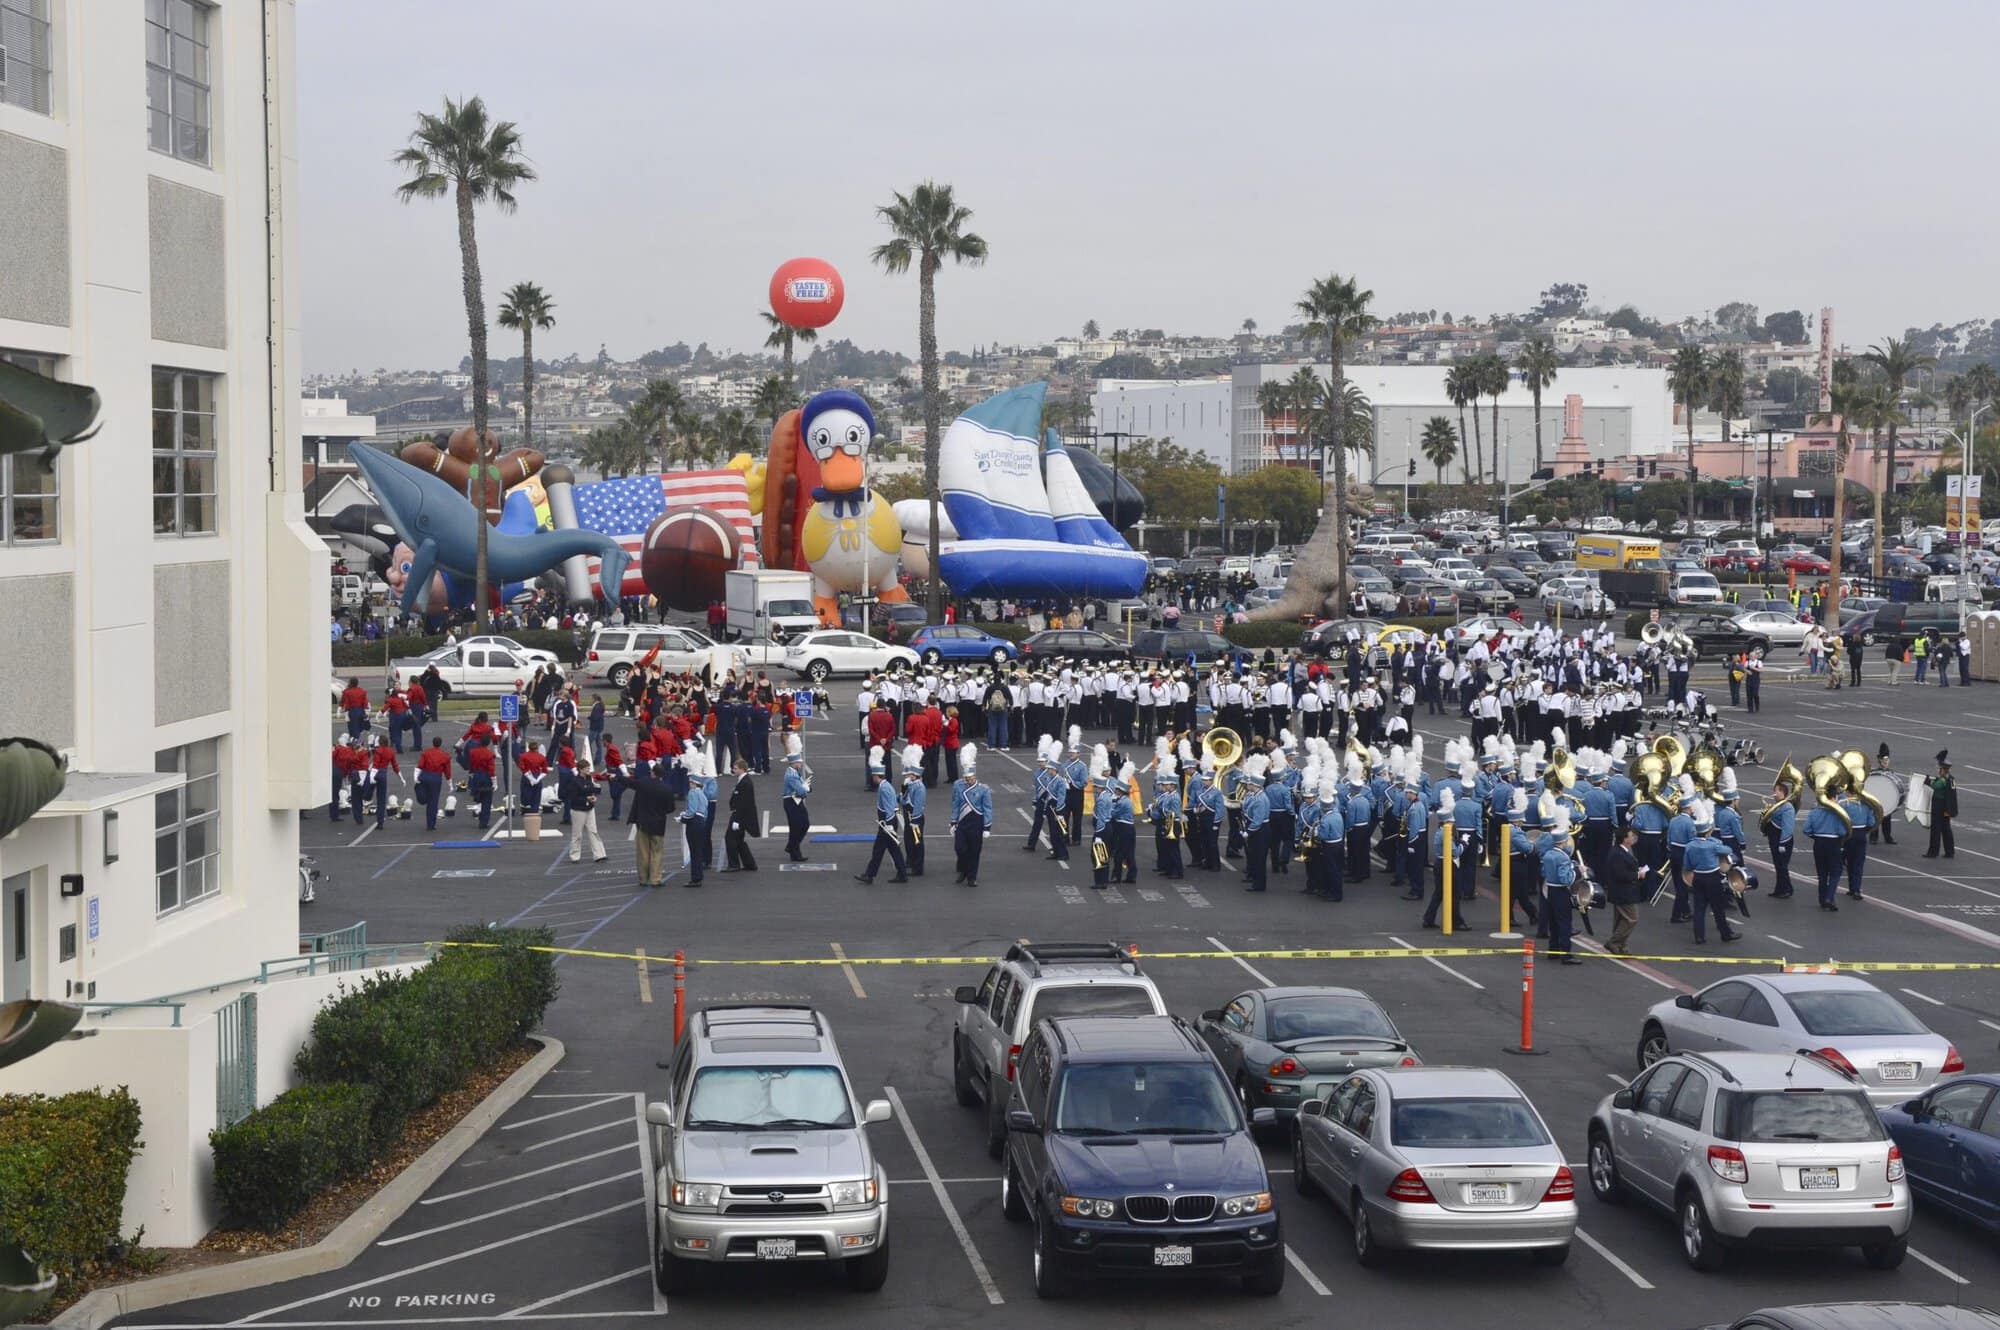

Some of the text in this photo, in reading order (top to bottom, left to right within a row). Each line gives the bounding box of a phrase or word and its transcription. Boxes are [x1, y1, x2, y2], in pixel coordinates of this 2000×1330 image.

[795, 282, 825, 290] TASTEE
[1821, 318, 1829, 399] CHINA CAMP
[348, 1293, 496, 1308] NO PARKING
